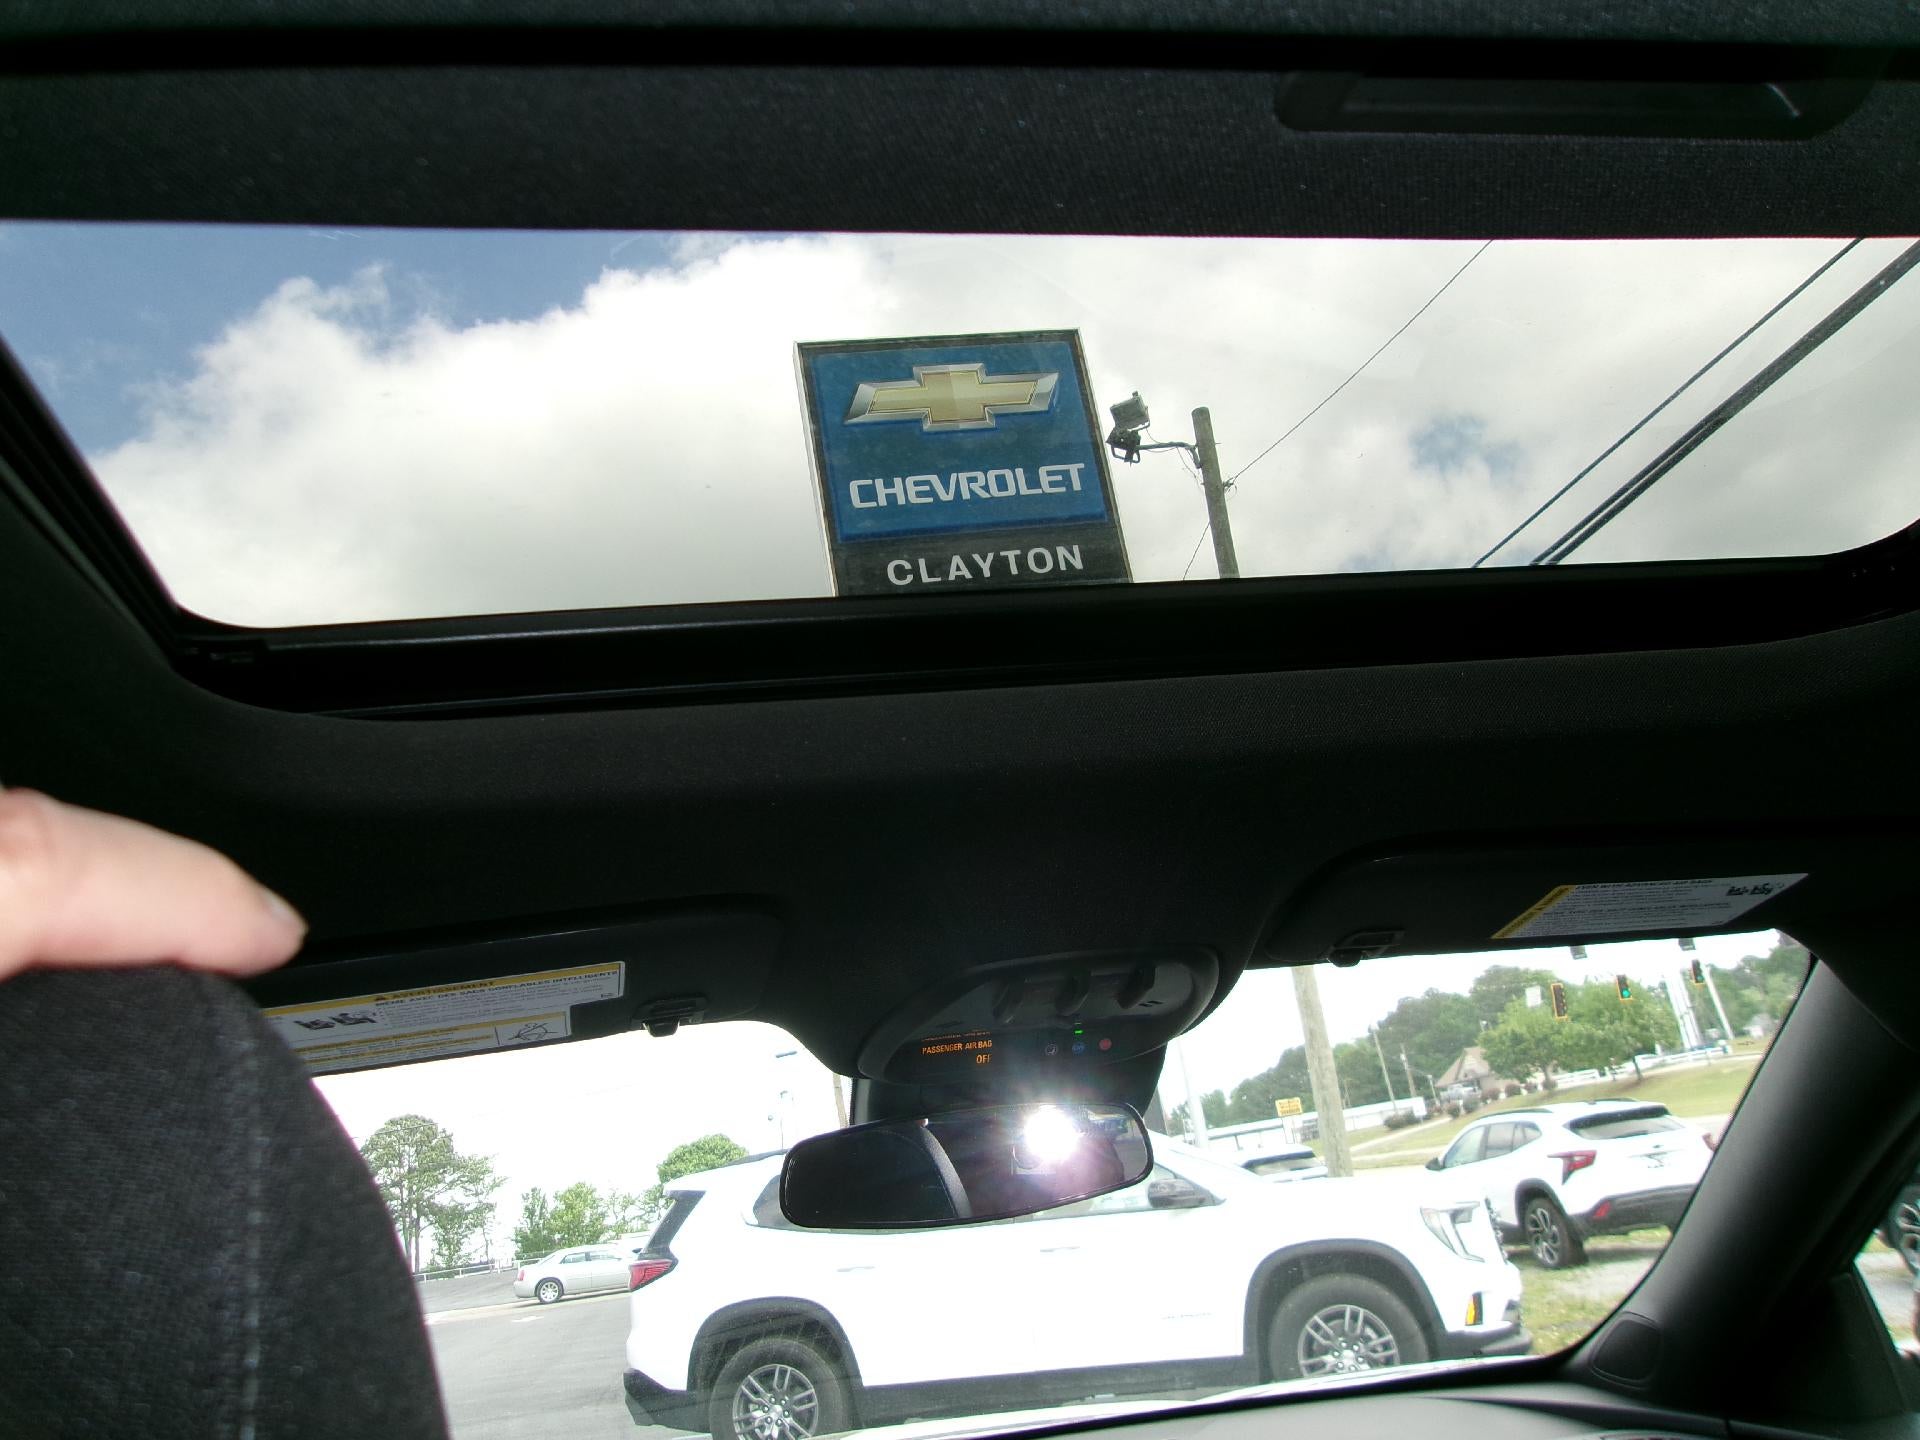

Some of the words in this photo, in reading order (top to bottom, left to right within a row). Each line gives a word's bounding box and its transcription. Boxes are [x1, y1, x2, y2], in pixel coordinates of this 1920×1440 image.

[850, 463, 1085, 509] CHEVROLET
[886, 544, 1084, 586] CLAYTON
[922, 1043, 962, 1055] PASSENGER
